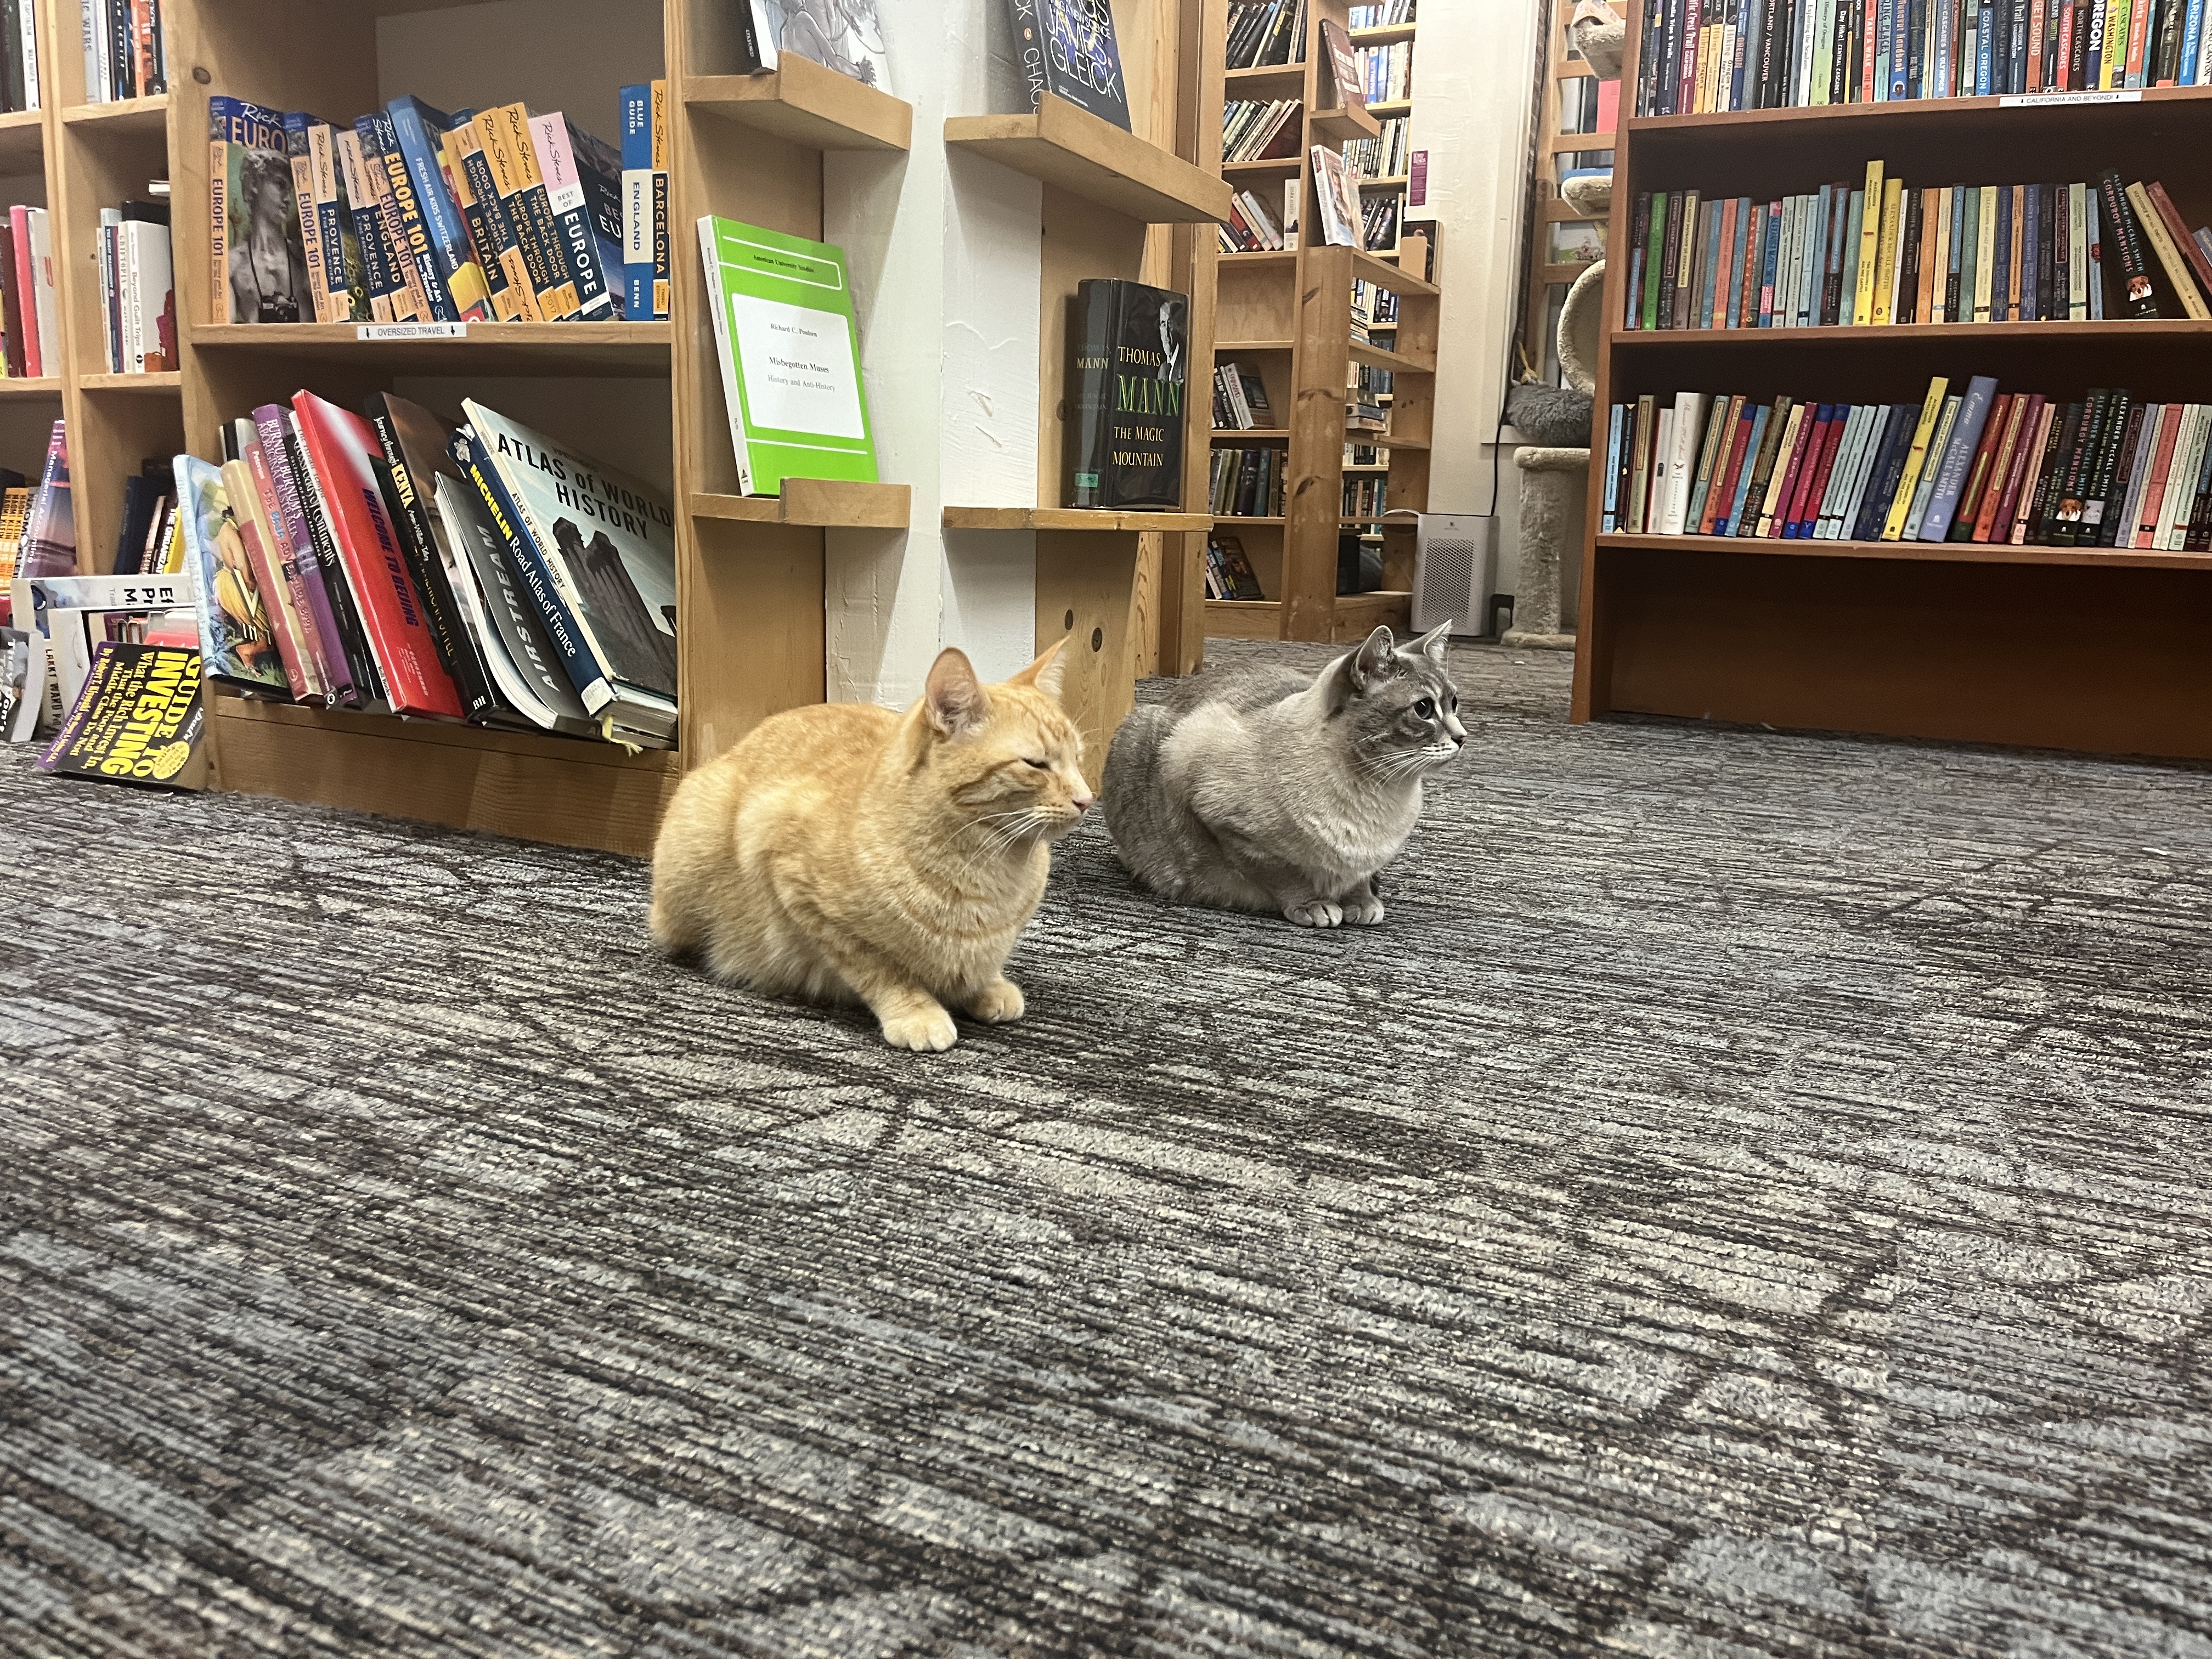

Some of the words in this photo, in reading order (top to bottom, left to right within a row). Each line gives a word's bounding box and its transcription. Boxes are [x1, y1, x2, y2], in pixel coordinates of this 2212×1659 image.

[1686, 12, 1697, 31] Crest
[1804, 4, 1813, 33] Exploring
[1939, 10, 1949, 47] CASCADES
[1979, 10, 1991, 50] COASTAL
[2013, 4, 2024, 22] Trail
[2062, 7, 2070, 32] SOUTH
[2076, 9, 2084, 35] NORTH
[2186, 0, 2200, 42] ARIZONA
[1046, 4, 1107, 65] JAMES
[1685, 31, 1696, 49] Trail
[1894, 33, 1906, 72] Handbook
[2030, 21, 2042, 56] SOUND
[2059, 33, 2068, 69] CASCADES
[2104, 15, 2116, 64] WASHINGTON
[1050, 37, 1122, 104] GLEICK
[1762, 37, 1771, 82] VANCOUVER
[1978, 52, 1989, 89] OREGON
[2072, 36, 2082, 71] CASCADES
[1938, 57, 1946, 92] OLYMPICS
[241, 102, 280, 127] Rick
[653, 89, 662, 120] Rick
[231, 116, 286, 152] EURO
[381, 118, 397, 147] Rick
[506, 108, 524, 139] Rick
[515, 137, 538, 184] Steves
[541, 121, 557, 150] Rick
[653, 120, 663, 167] Steves
[415, 157, 429, 183] FRESH
[481, 114, 500, 145] Rick
[491, 142, 515, 190] Steves
[548, 148, 567, 184] Steves
[424, 183, 434, 196] AIR
[465, 159, 490, 208] THROUGH
[475, 159, 492, 189] DOOR
[212, 178, 223, 232] EUROPE
[382, 151, 419, 222] EUROPE
[405, 223, 428, 255] 101
[428, 196, 440, 215] KIDS
[486, 191, 502, 219] BACK
[557, 191, 574, 201] BEST
[298, 192, 318, 245] EUROPE
[382, 193, 407, 245] EUROPE
[396, 245, 414, 268] 101
[487, 211, 504, 251] EUROPE
[497, 221, 510, 241] THE
[535, 188, 556, 229] EUROPE
[548, 229, 570, 279] THROUGH
[654, 178, 665, 273] BARCELONA
[2103, 178, 2121, 224] CORDUROY
[2115, 227, 2133, 272] MANSIONS
[2112, 173, 2130, 216] ALEXANDER
[2124, 218, 2137, 246] McCALL
[2131, 249, 2145, 272] SMITH
[213, 236, 223, 255] 101
[327, 209, 342, 284] PROVENCE
[359, 214, 383, 289] PROVENCE
[374, 210, 402, 283] ENGLAND
[434, 215, 459, 270] SWITZERLAND
[470, 216, 498, 281] BRITAIN
[507, 201, 520, 222] THE
[516, 225, 531, 252] BACK
[526, 255, 541, 284] DOOR
[514, 193, 533, 233] EUROPE
[528, 235, 551, 284] THROUGH
[529, 196, 541, 216] THE
[536, 219, 551, 246] BACK
[545, 249, 561, 279] DOOR
[562, 212, 600, 295] EUROPE
[307, 247, 320, 268] 101
[130, 272, 139, 302] Beyond
[544, 293, 556, 314] 2017
[134, 327, 142, 346] Trips
[378, 328, 416, 336] OVERSIZED
[418, 327, 445, 335] TRAVEL
[771, 323, 790, 332] Richard
[769, 357, 808, 370] Misbegotten
[809, 363, 829, 373] Muses
[1076, 357, 1109, 369] MANN
[1117, 346, 1161, 367] THOMAS
[768, 375, 788, 386] History
[803, 380, 836, 392] Anti-History
[1115, 374, 1184, 417] MANN
[373, 415, 392, 443] Journey
[1113, 426, 1131, 441] THE
[1135, 426, 1165, 442] MAGIC
[2076, 396, 2095, 443] CORDUROY
[2088, 394, 2106, 439] ALEXANDER
[2112, 396, 2129, 440] ALEXANDER
[252, 450, 266, 479] Peterson
[265, 418, 290, 464] BURNUM
[279, 464, 305, 520] BURNUM'S
[382, 440, 400, 466] through
[1112, 451, 1164, 467] MOUNTAIN
[2065, 447, 2083, 492] MANSIONS
[2105, 442, 2117, 471] McCALL
[41, 450, 58, 505] Managerial
[256, 422, 284, 483] ABORIGINAL
[275, 484, 299, 539] AUSTRALIA
[392, 464, 415, 508] KENYA
[498, 433, 568, 481] ATLAS
[576, 471, 595, 490] of
[602, 483, 673, 527] WORLD
[2074, 472, 2087, 496] SMITH
[2098, 473, 2110, 497] SMITH
[554, 482, 649, 540] HISTORY
[27, 507, 44, 563] Accounting
[313, 506, 336, 567] Continents
[510, 492, 527, 514] ATLAS
[523, 516, 533, 526] OF
[529, 528, 549, 555] WORLD
[545, 557, 566, 589] HISTORY
[364, 489, 394, 554] WELCOME
[386, 556, 401, 573] TO
[397, 575, 419, 627] BEIJING
[470, 465, 513, 540] MICHELIN
[509, 536, 531, 572] Road
[526, 570, 546, 601] Atlas
[541, 597, 557, 615] of
[549, 613, 577, 658] France
[477, 524, 560, 691] AIRSTREAM
[105, 662, 125, 693] Middle
[117, 669, 133, 690] That
[133, 651, 155, 678] What
[110, 692, 122, 708] the
[126, 681, 143, 697] the
[157, 656, 201, 738] GUIDE
[92, 696, 110, 720] Class
[96, 710, 115, 732] Poor
[100, 651, 189, 775] INVESTING
[112, 699, 136, 722] Rich
[83, 721, 97, 736] Do
[84, 733, 99, 752] and
[94, 724, 122, 754] Invest
[81, 755, 103, 769] In,
